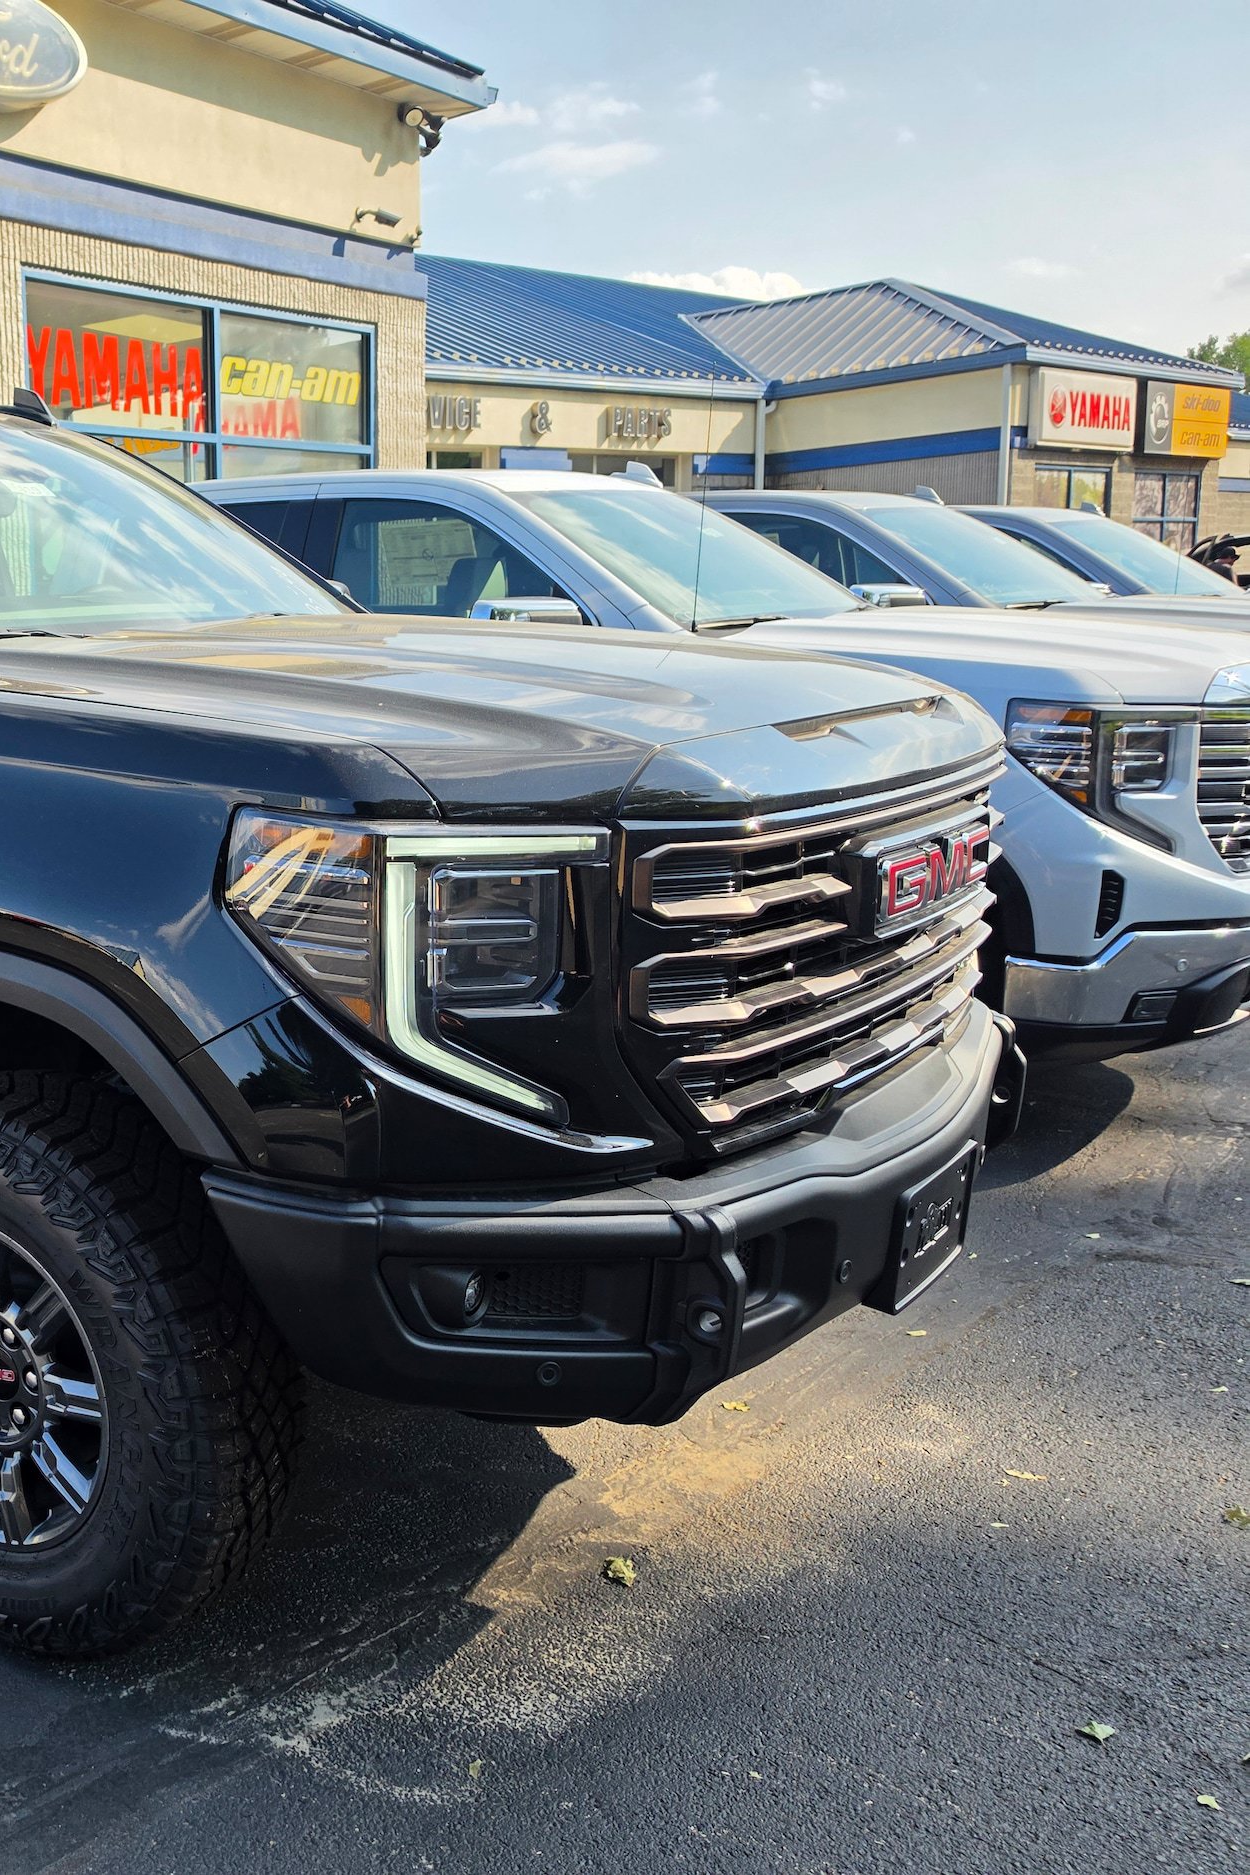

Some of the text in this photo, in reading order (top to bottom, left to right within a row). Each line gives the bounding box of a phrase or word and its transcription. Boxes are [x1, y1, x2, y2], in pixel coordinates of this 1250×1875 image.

[27, 323, 206, 419] YAMAHA
[220, 354, 361, 405] can-am
[531, 400, 552, 434] &
[612, 406, 672, 438] PARTS
[1069, 391, 1131, 431] YAMAHA
[1182, 393, 1221, 412] ski-doo
[1180, 431, 1221, 447] can-am
[883, 823, 990, 919] GMC
